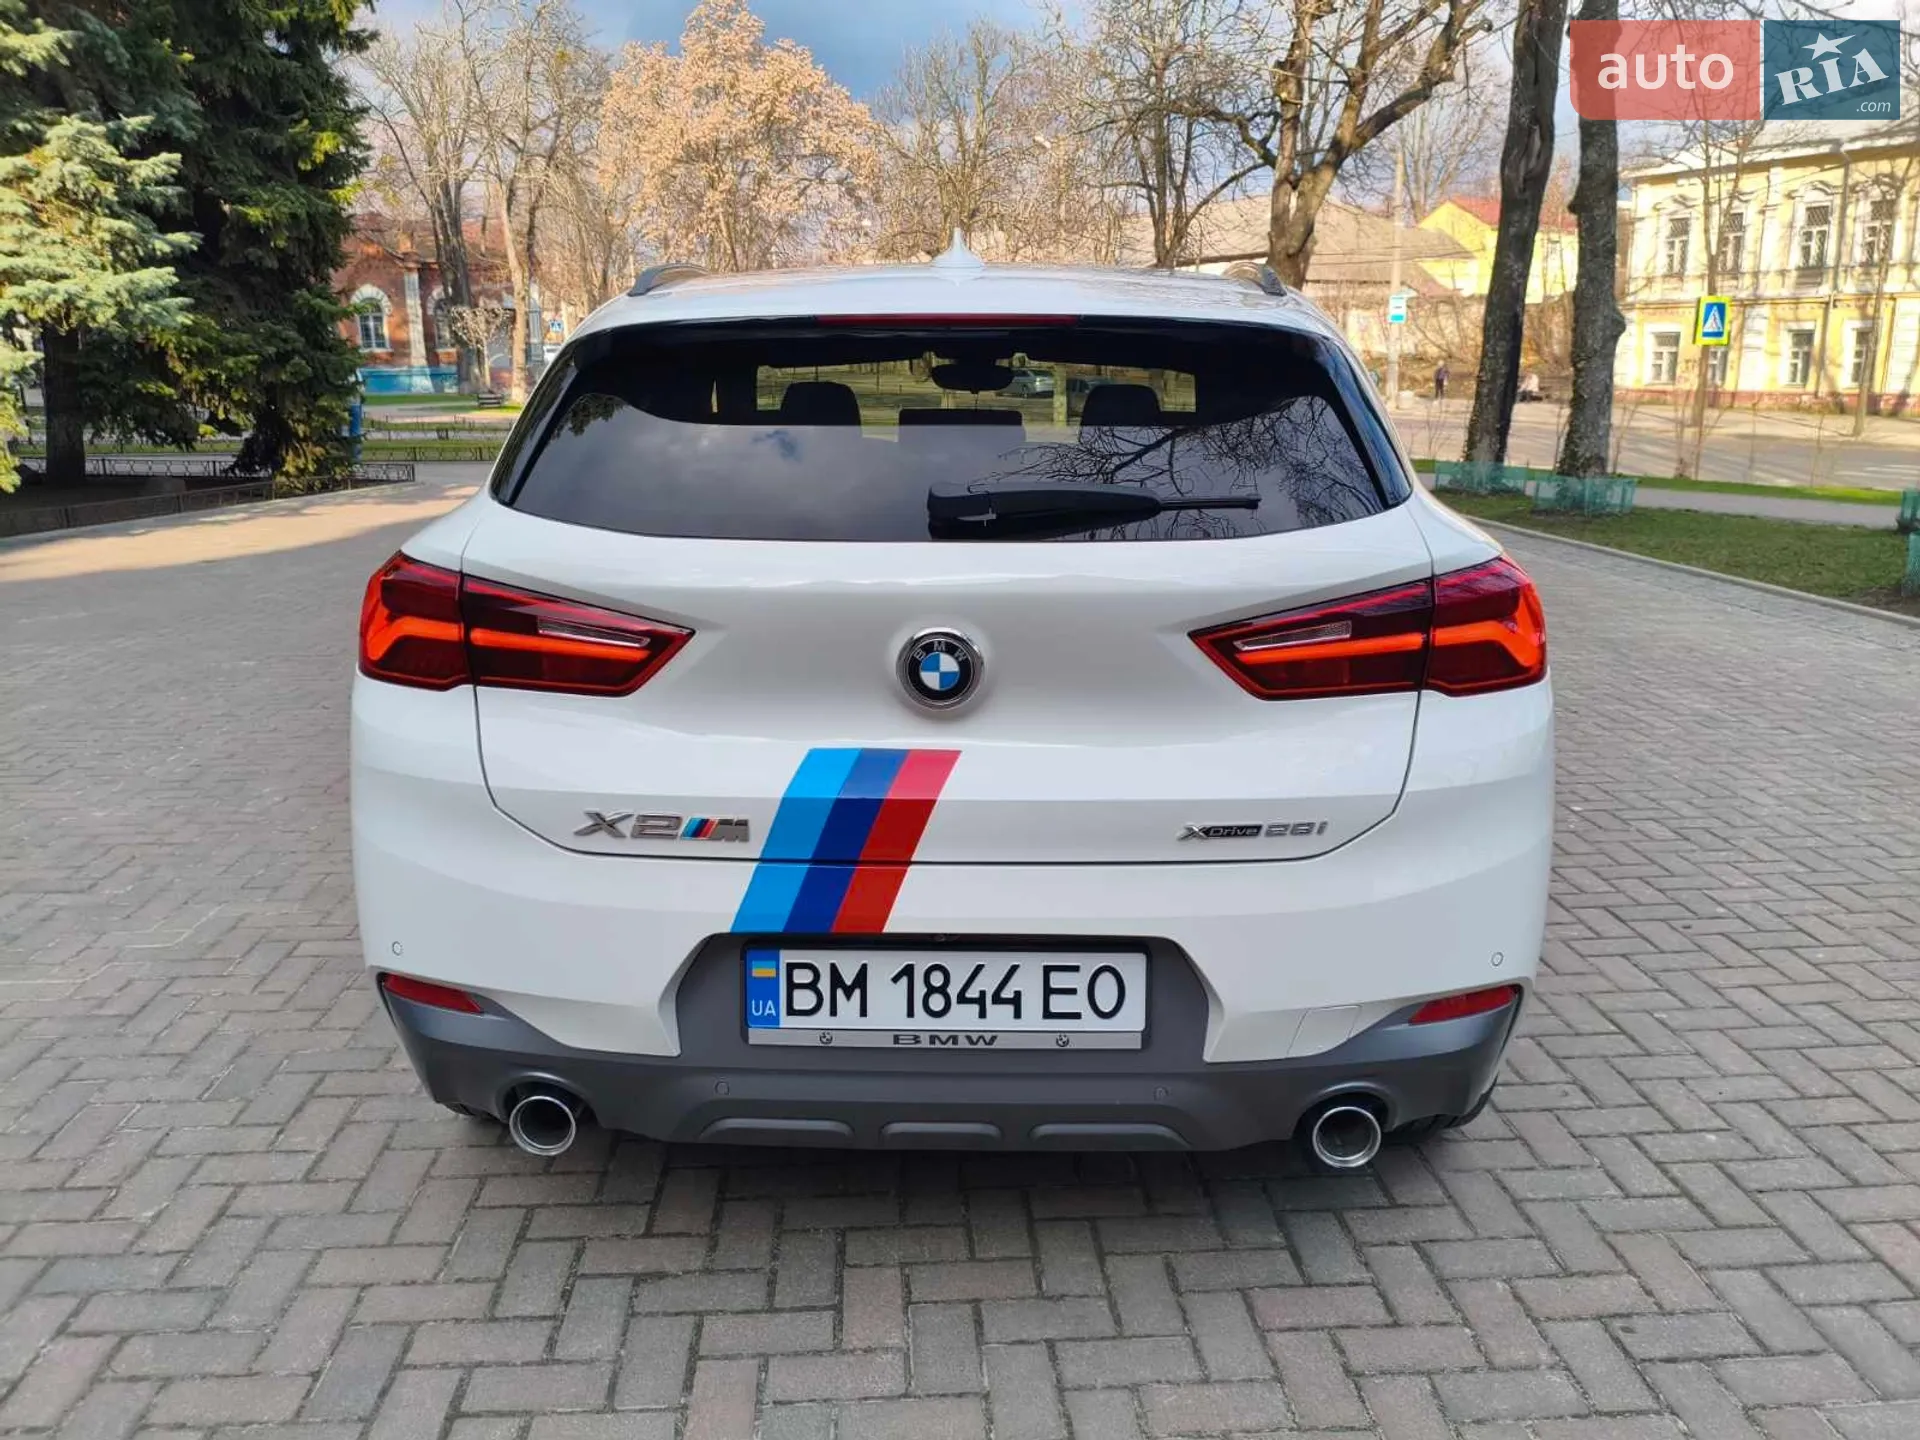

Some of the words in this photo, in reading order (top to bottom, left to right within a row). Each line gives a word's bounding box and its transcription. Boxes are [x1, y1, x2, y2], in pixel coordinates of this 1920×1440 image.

[913, 640, 966, 661] BMW
[573, 811, 683, 840] X2
[785, 961, 868, 1018] BM
[890, 963, 1022, 1020] 1844
[1042, 963, 1126, 1020] EO
[751, 999, 776, 1017] UA
[892, 1034, 998, 1047] BMW
